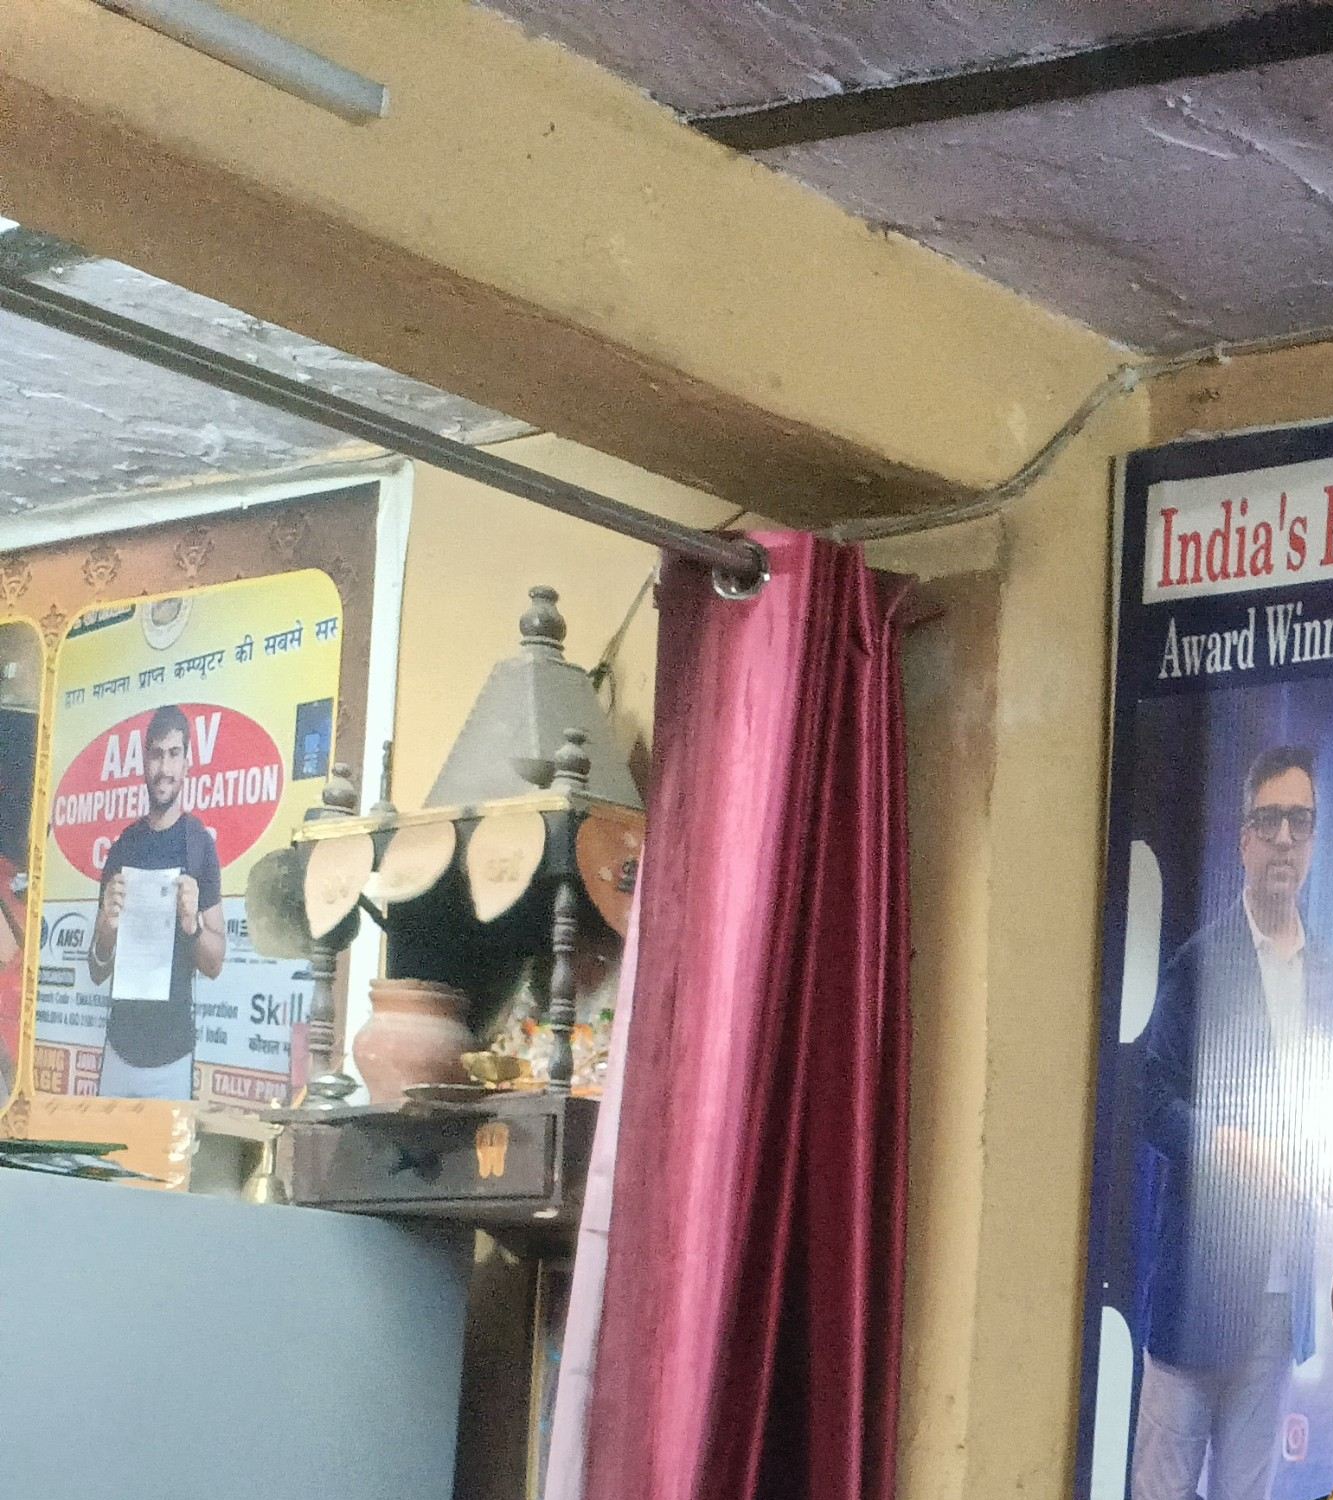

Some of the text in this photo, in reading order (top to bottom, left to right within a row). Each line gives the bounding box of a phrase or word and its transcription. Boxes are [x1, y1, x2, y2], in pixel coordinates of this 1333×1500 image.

[1157, 503, 1309, 590] India's
[1159, 618, 1255, 680] Award
[102, 712, 222, 782] AAV
[182, 764, 279, 812] UCATION
[56, 929, 84, 947] ANSI
